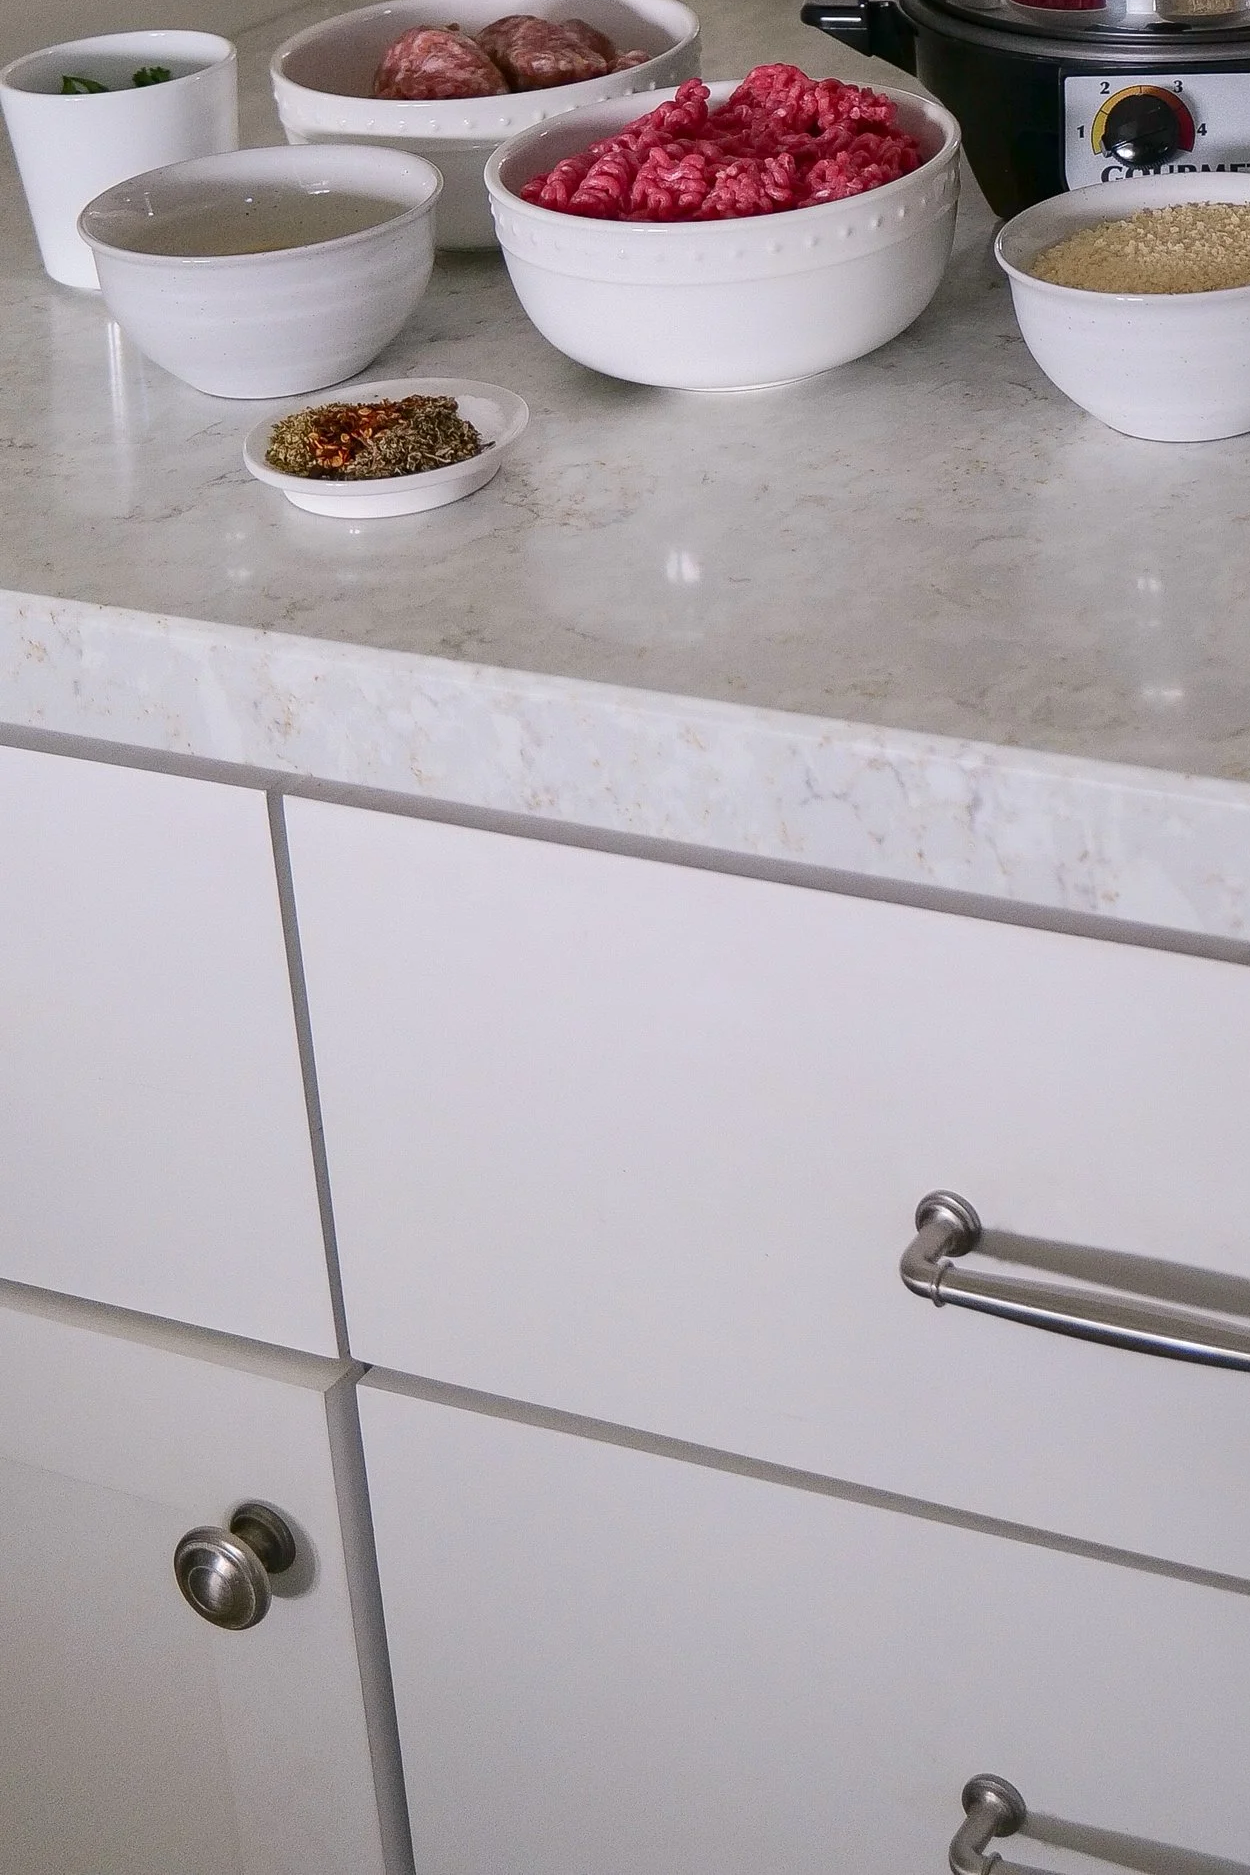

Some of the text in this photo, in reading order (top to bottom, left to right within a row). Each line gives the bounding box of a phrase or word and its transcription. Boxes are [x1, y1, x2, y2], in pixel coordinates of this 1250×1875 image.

[1099, 81, 1110, 95] 2
[1173, 80, 1183, 93] 3
[1076, 125, 1085, 138] 1
[1196, 123, 1208, 136] 4
